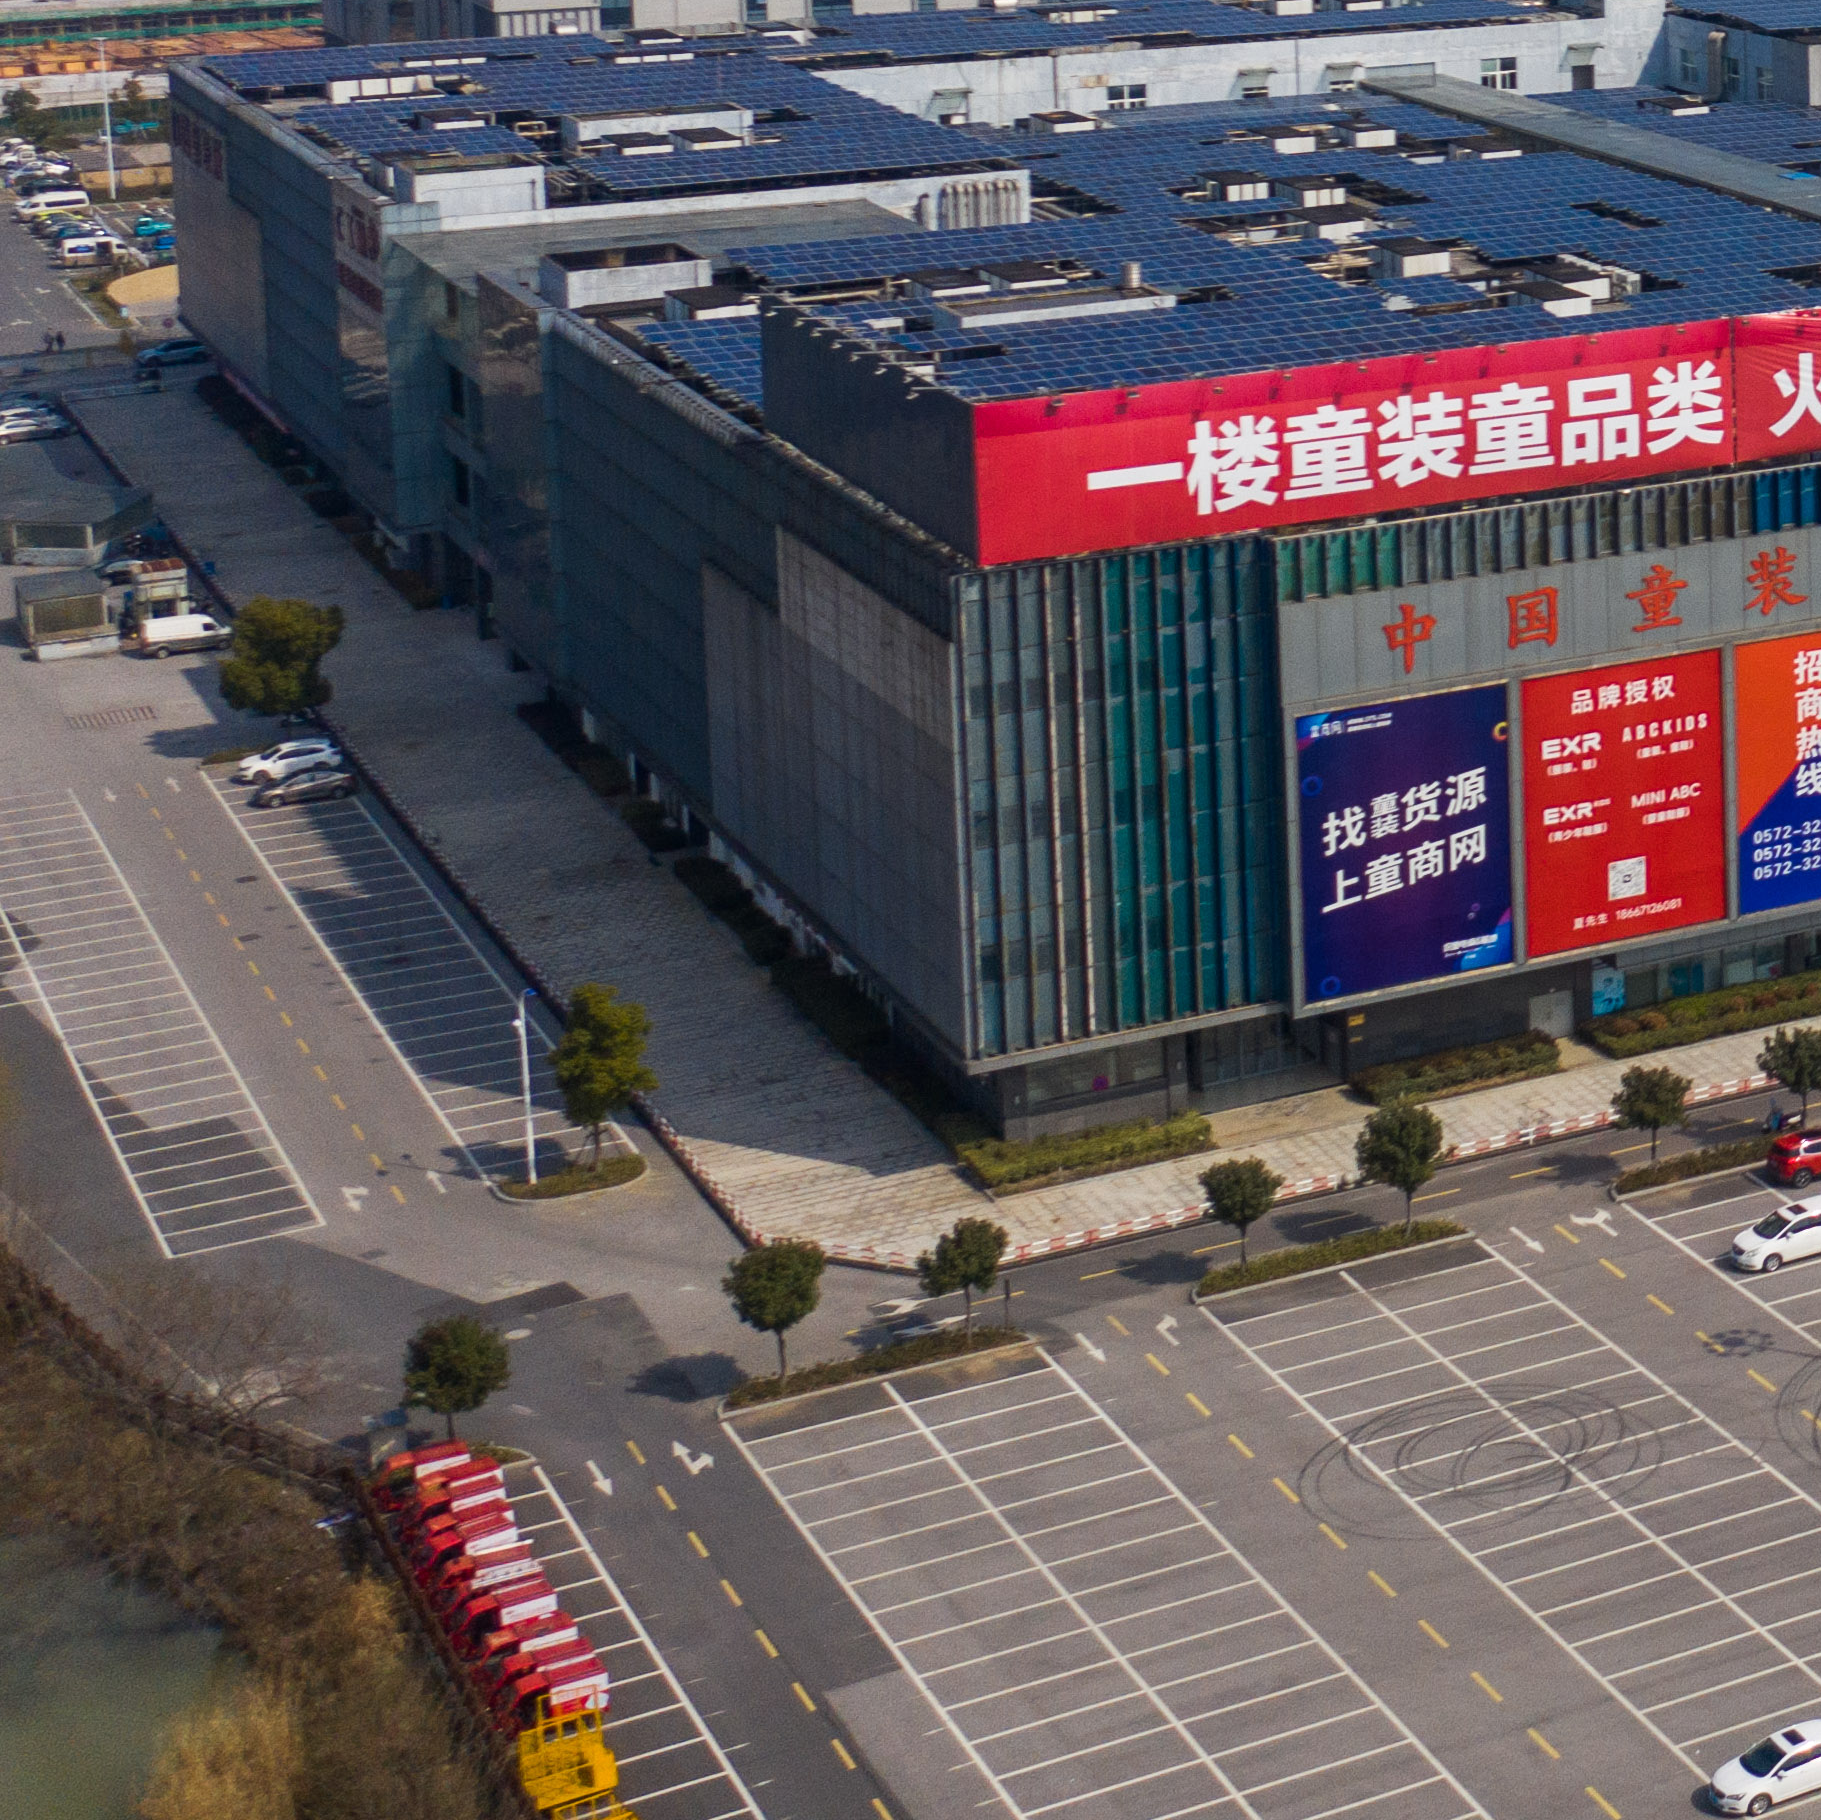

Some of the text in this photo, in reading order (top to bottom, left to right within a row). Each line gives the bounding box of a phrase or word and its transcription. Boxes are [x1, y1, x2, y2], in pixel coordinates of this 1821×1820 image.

[1087, 361, 1725, 516] 一楼童装童品类
[1571, 675, 1675, 715] 品牌授权
[1541, 732, 1601, 760] EXR
[1321, 766, 1487, 857] 找童装货源
[1631, 789, 1666, 808] MINI
[1669, 782, 1701, 800] ABC
[1320, 824, 1487, 913] 上童商网
